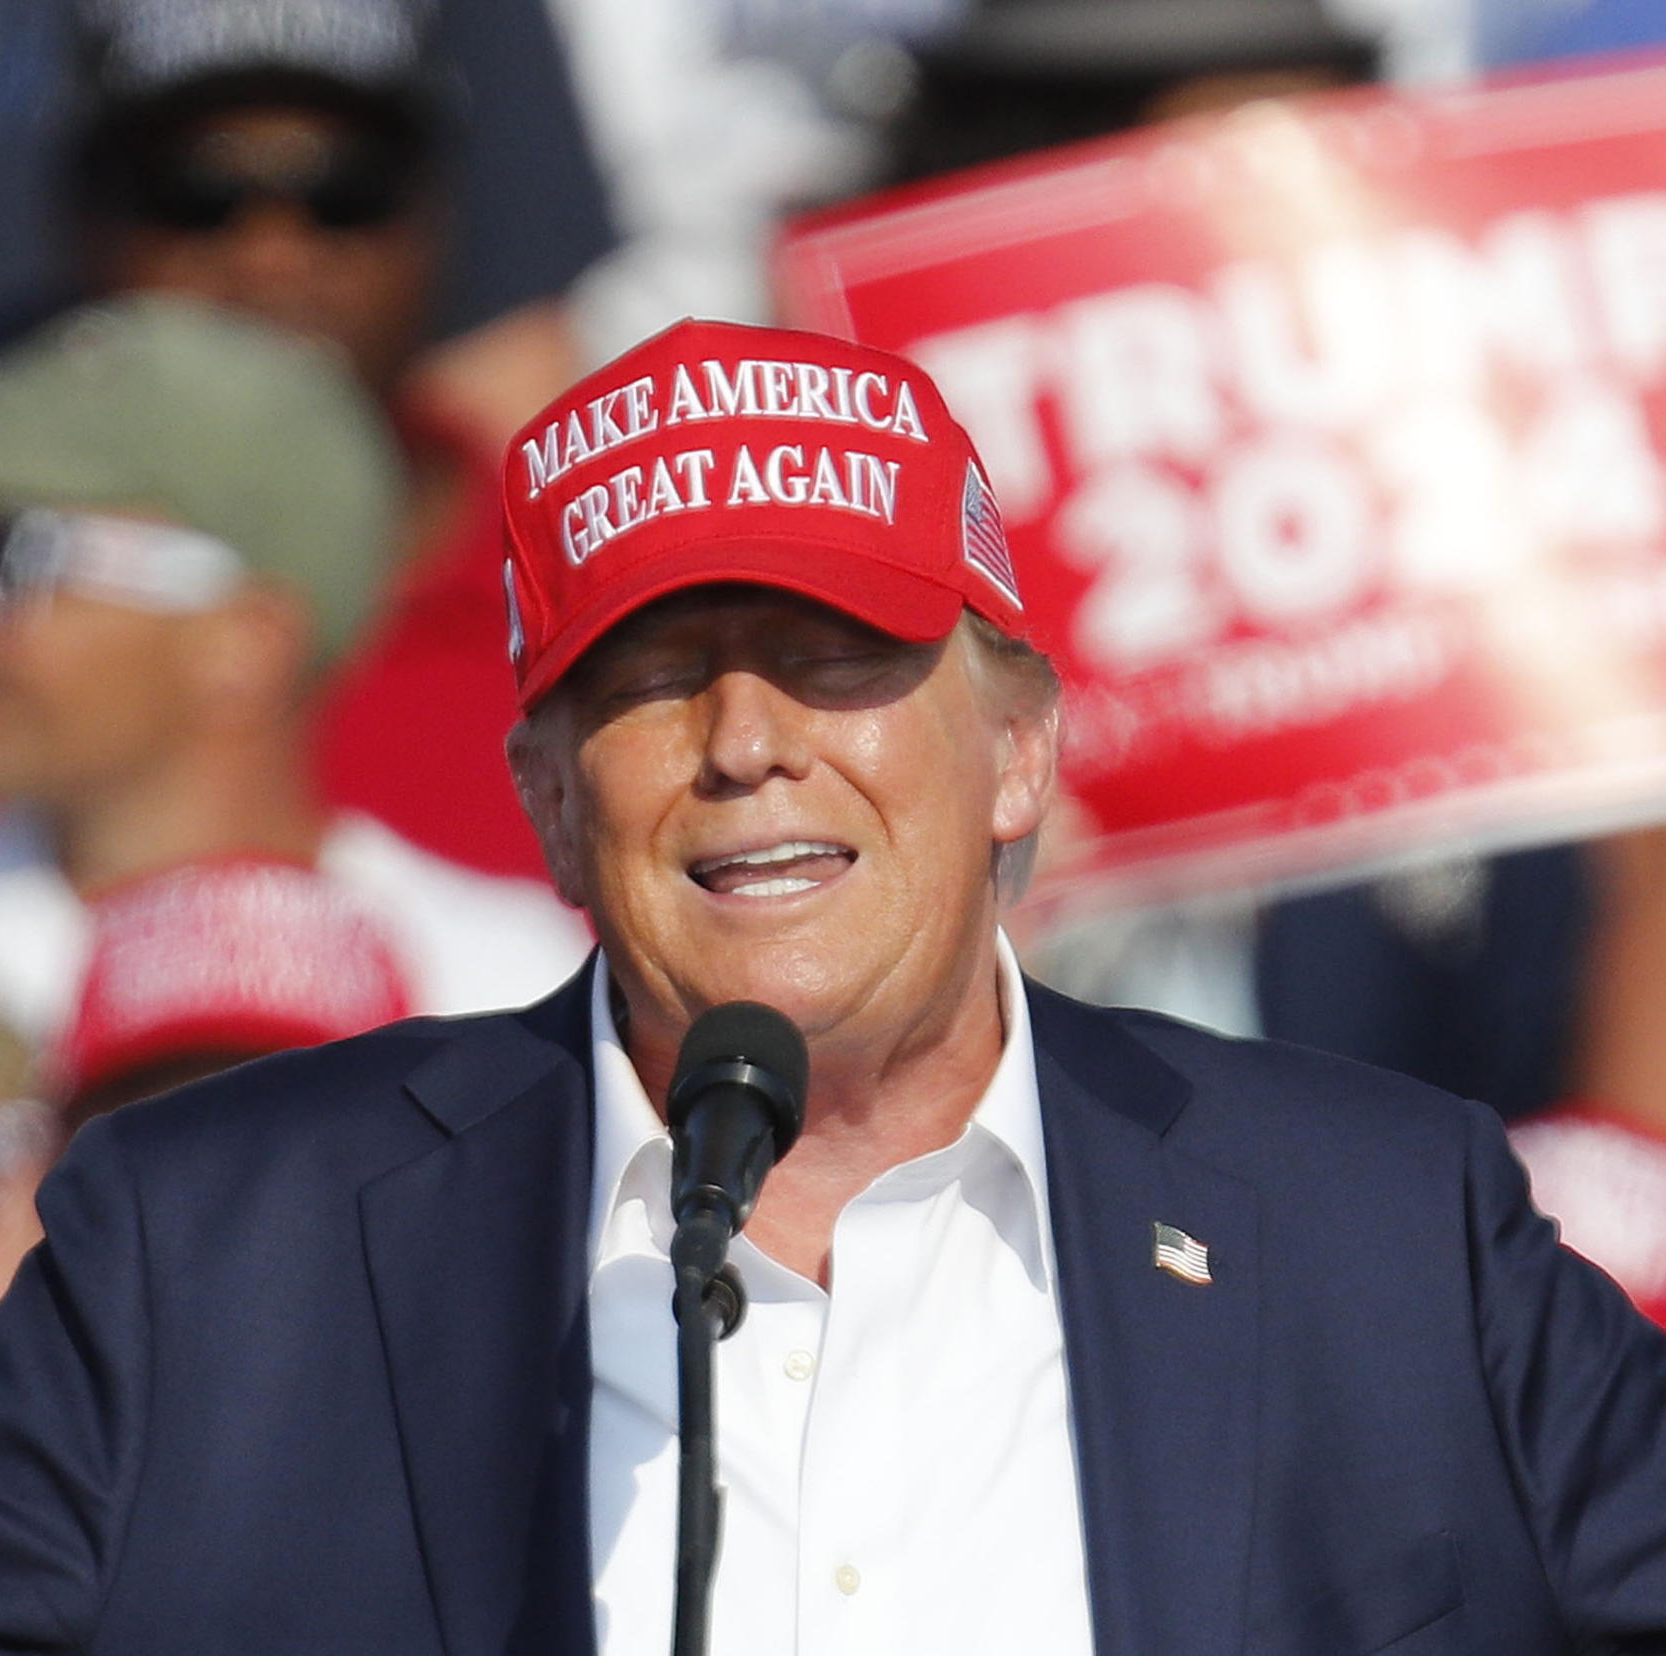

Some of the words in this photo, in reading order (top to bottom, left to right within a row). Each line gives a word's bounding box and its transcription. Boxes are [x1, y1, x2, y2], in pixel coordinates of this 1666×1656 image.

[520, 374, 662, 501] MAKE
[665, 358, 930, 444] AMERICA
[561, 447, 717, 568] GREAT
[727, 443, 902, 527] AGAIN
